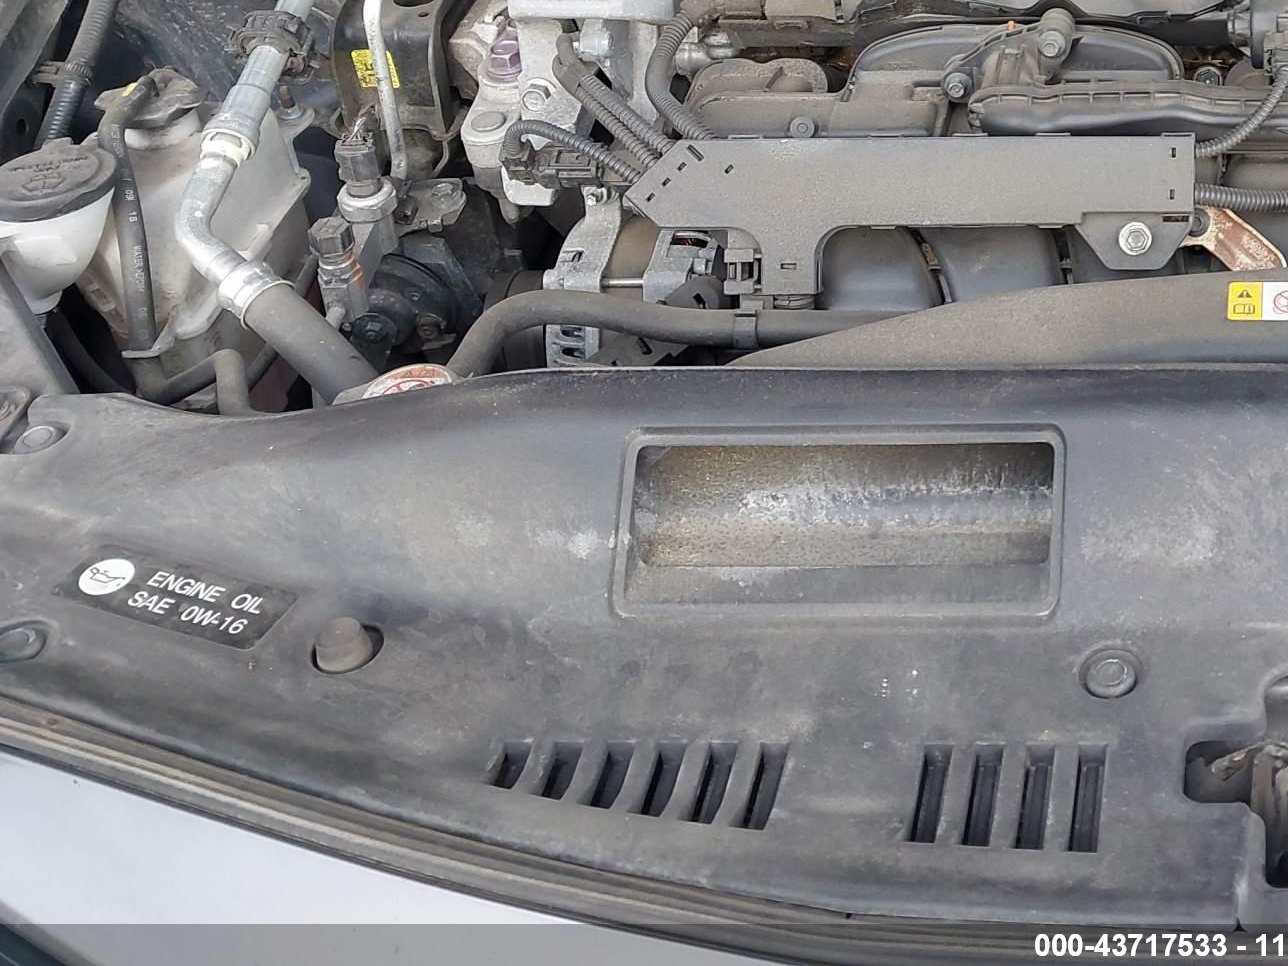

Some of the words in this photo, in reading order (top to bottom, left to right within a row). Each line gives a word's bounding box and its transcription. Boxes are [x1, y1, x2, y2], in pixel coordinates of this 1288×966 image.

[127, 591, 175, 614] SAE
[180, 605, 248, 634] 0W-16
[147, 571, 226, 602] ENGINE
[230, 593, 264, 614] OIL
